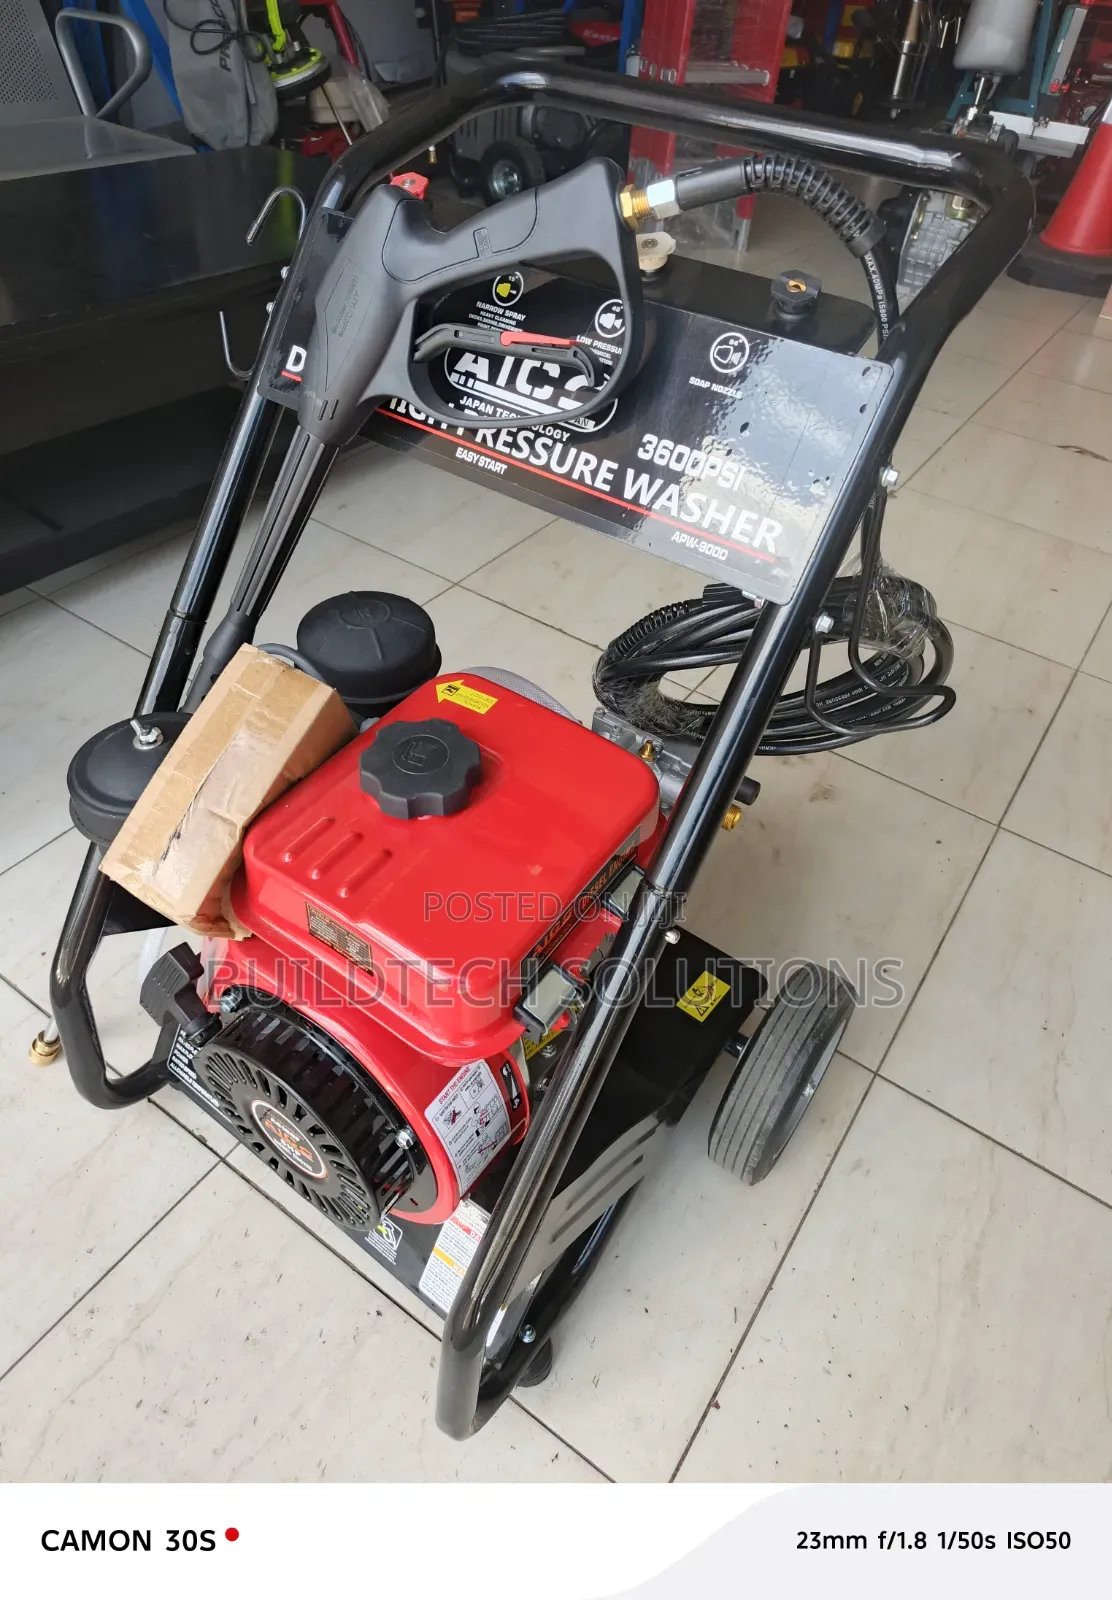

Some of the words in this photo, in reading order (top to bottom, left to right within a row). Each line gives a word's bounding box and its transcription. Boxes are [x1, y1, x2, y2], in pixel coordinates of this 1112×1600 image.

[475, 301, 505, 315] NARROW
[504, 309, 527, 322] SPRAY
[480, 311, 495, 319] HEAVY
[494, 315, 517, 326] CLEANING
[576, 334, 593, 346] LOW
[688, 376, 711, 389] SOAP
[710, 383, 743, 399] NOZZLE
[459, 396, 495, 415] JAPAN
[455, 447, 480, 466] EASY
[478, 456, 508, 475] START
[637, 433, 747, 491] 3600PSI
[457, 409, 619, 492] RESSURE
[623, 467, 783, 554] WASHER
[438, 1088, 452, 1105] START
[449, 1079, 460, 1093] THE
[456, 1065, 471, 1083] ENGINE
